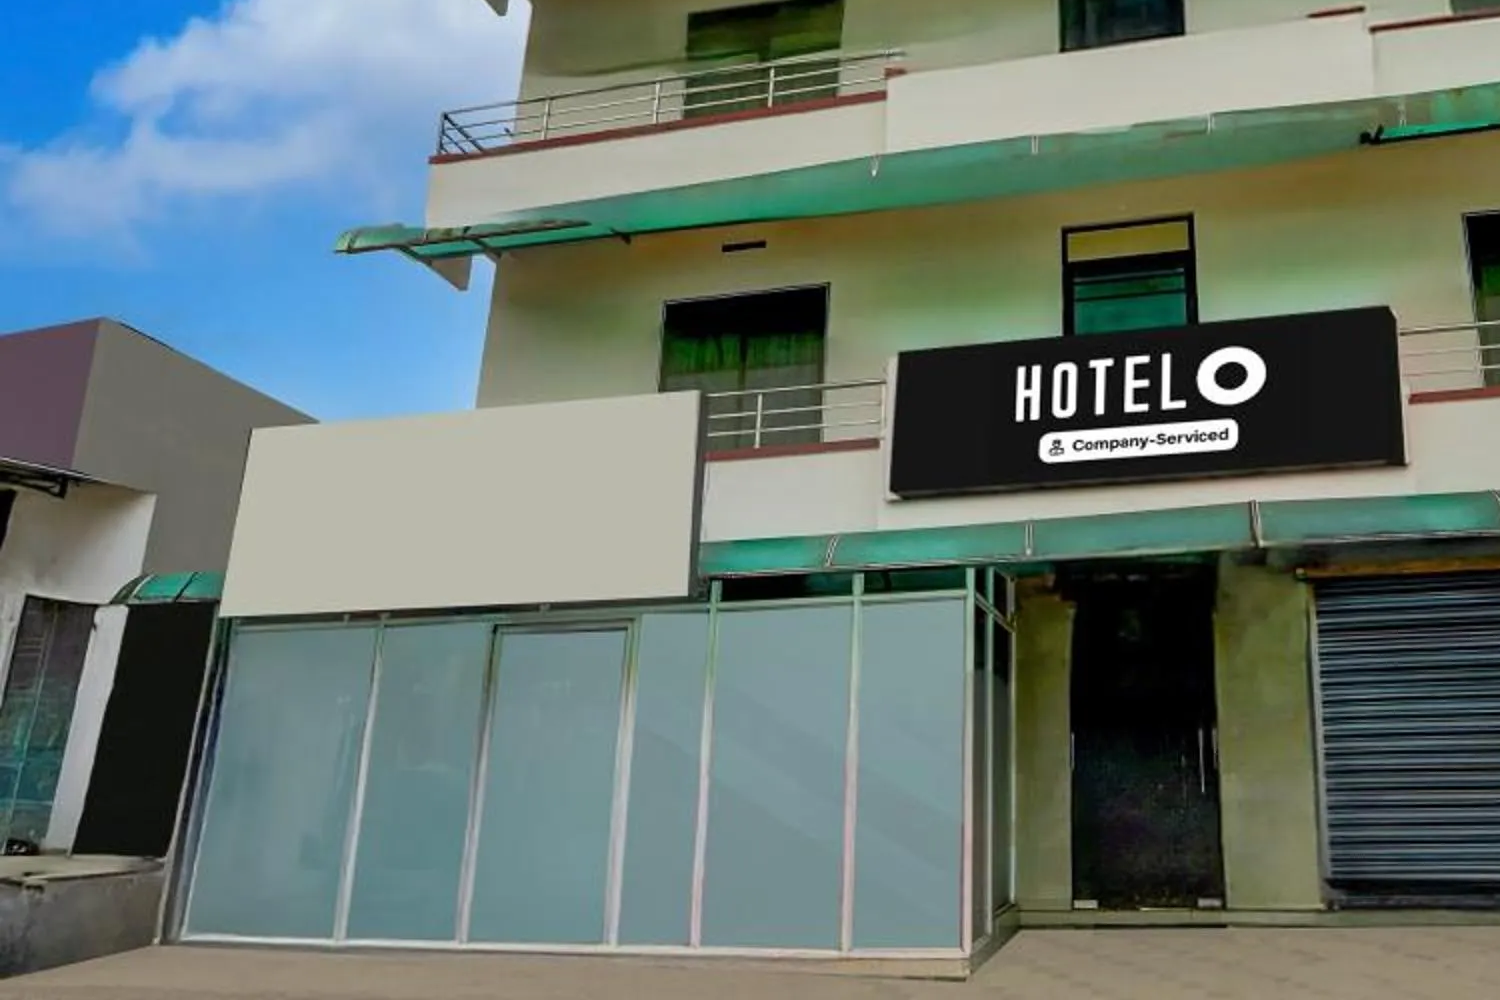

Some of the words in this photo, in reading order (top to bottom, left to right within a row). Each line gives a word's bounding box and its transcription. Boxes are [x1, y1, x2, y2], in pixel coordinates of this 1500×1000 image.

[1016, 353, 1187, 422] HOTEL
[1197, 346, 1267, 406] O
[1072, 428, 1230, 453] Company-Serviced
